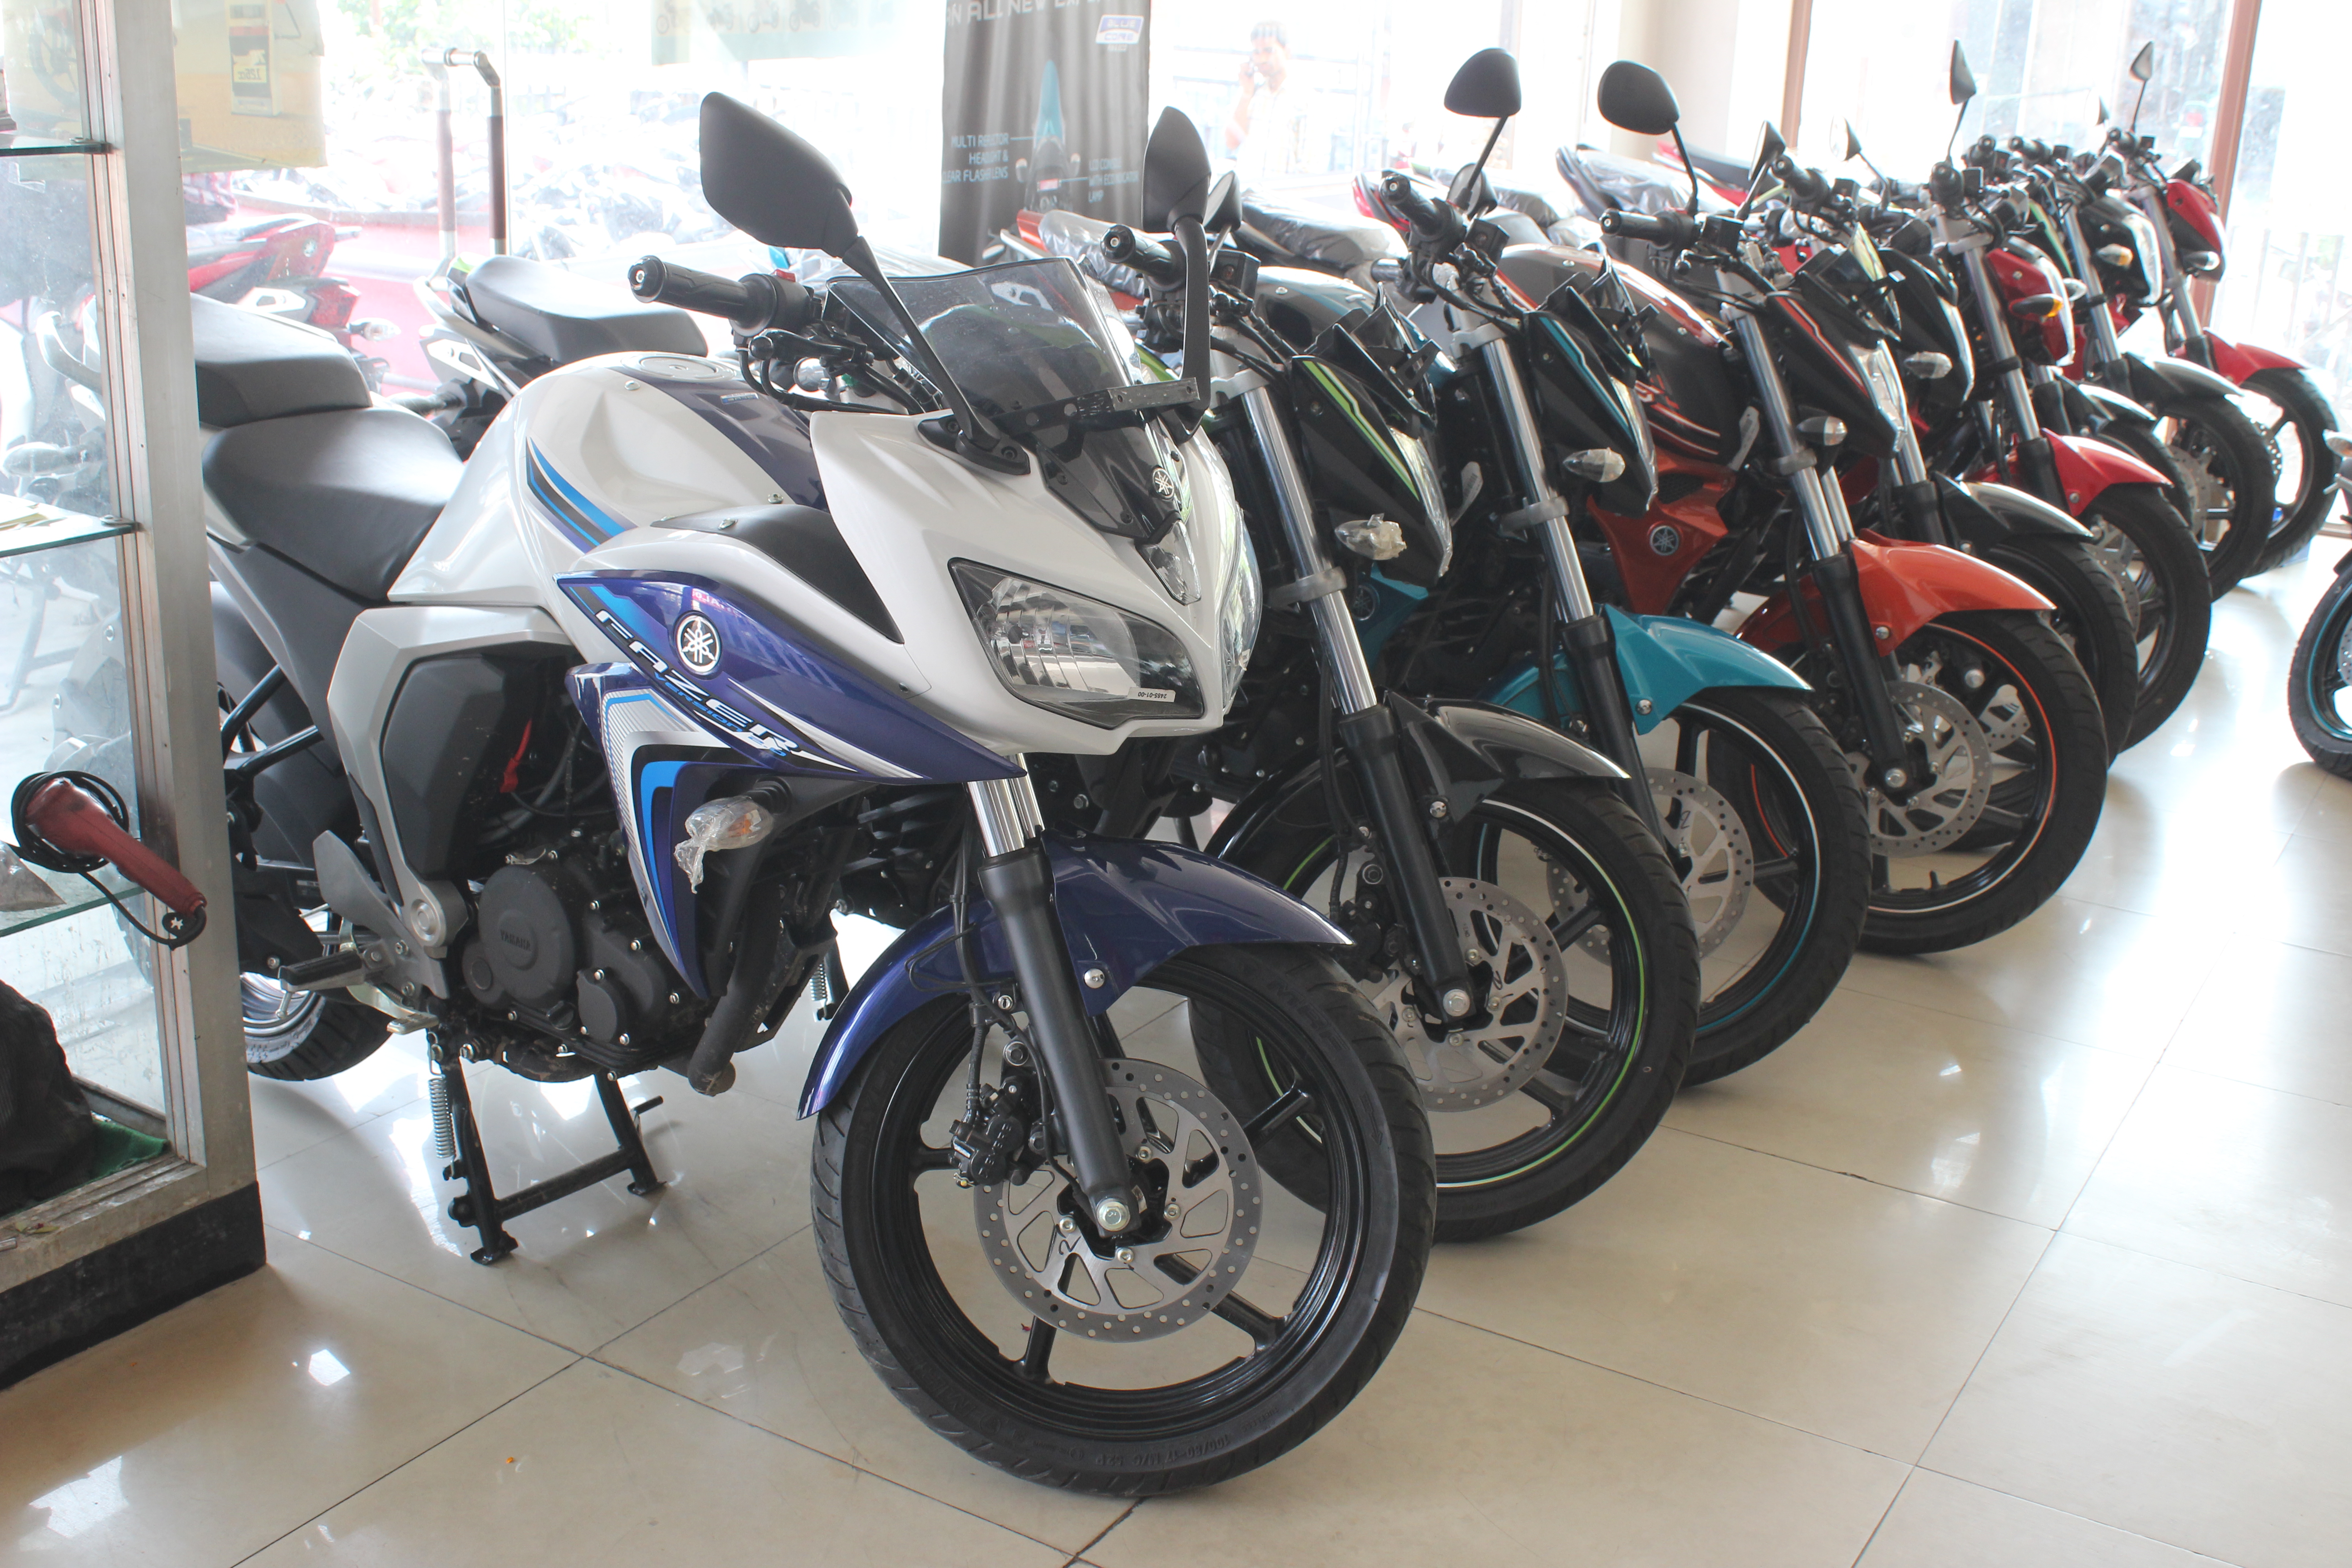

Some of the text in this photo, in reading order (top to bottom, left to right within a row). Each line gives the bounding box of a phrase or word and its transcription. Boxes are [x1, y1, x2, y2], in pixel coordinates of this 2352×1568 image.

[968, 0, 1003, 22] ALL
[595, 609, 799, 752] FAZER
[500, 928, 532, 952] YAMAHA
